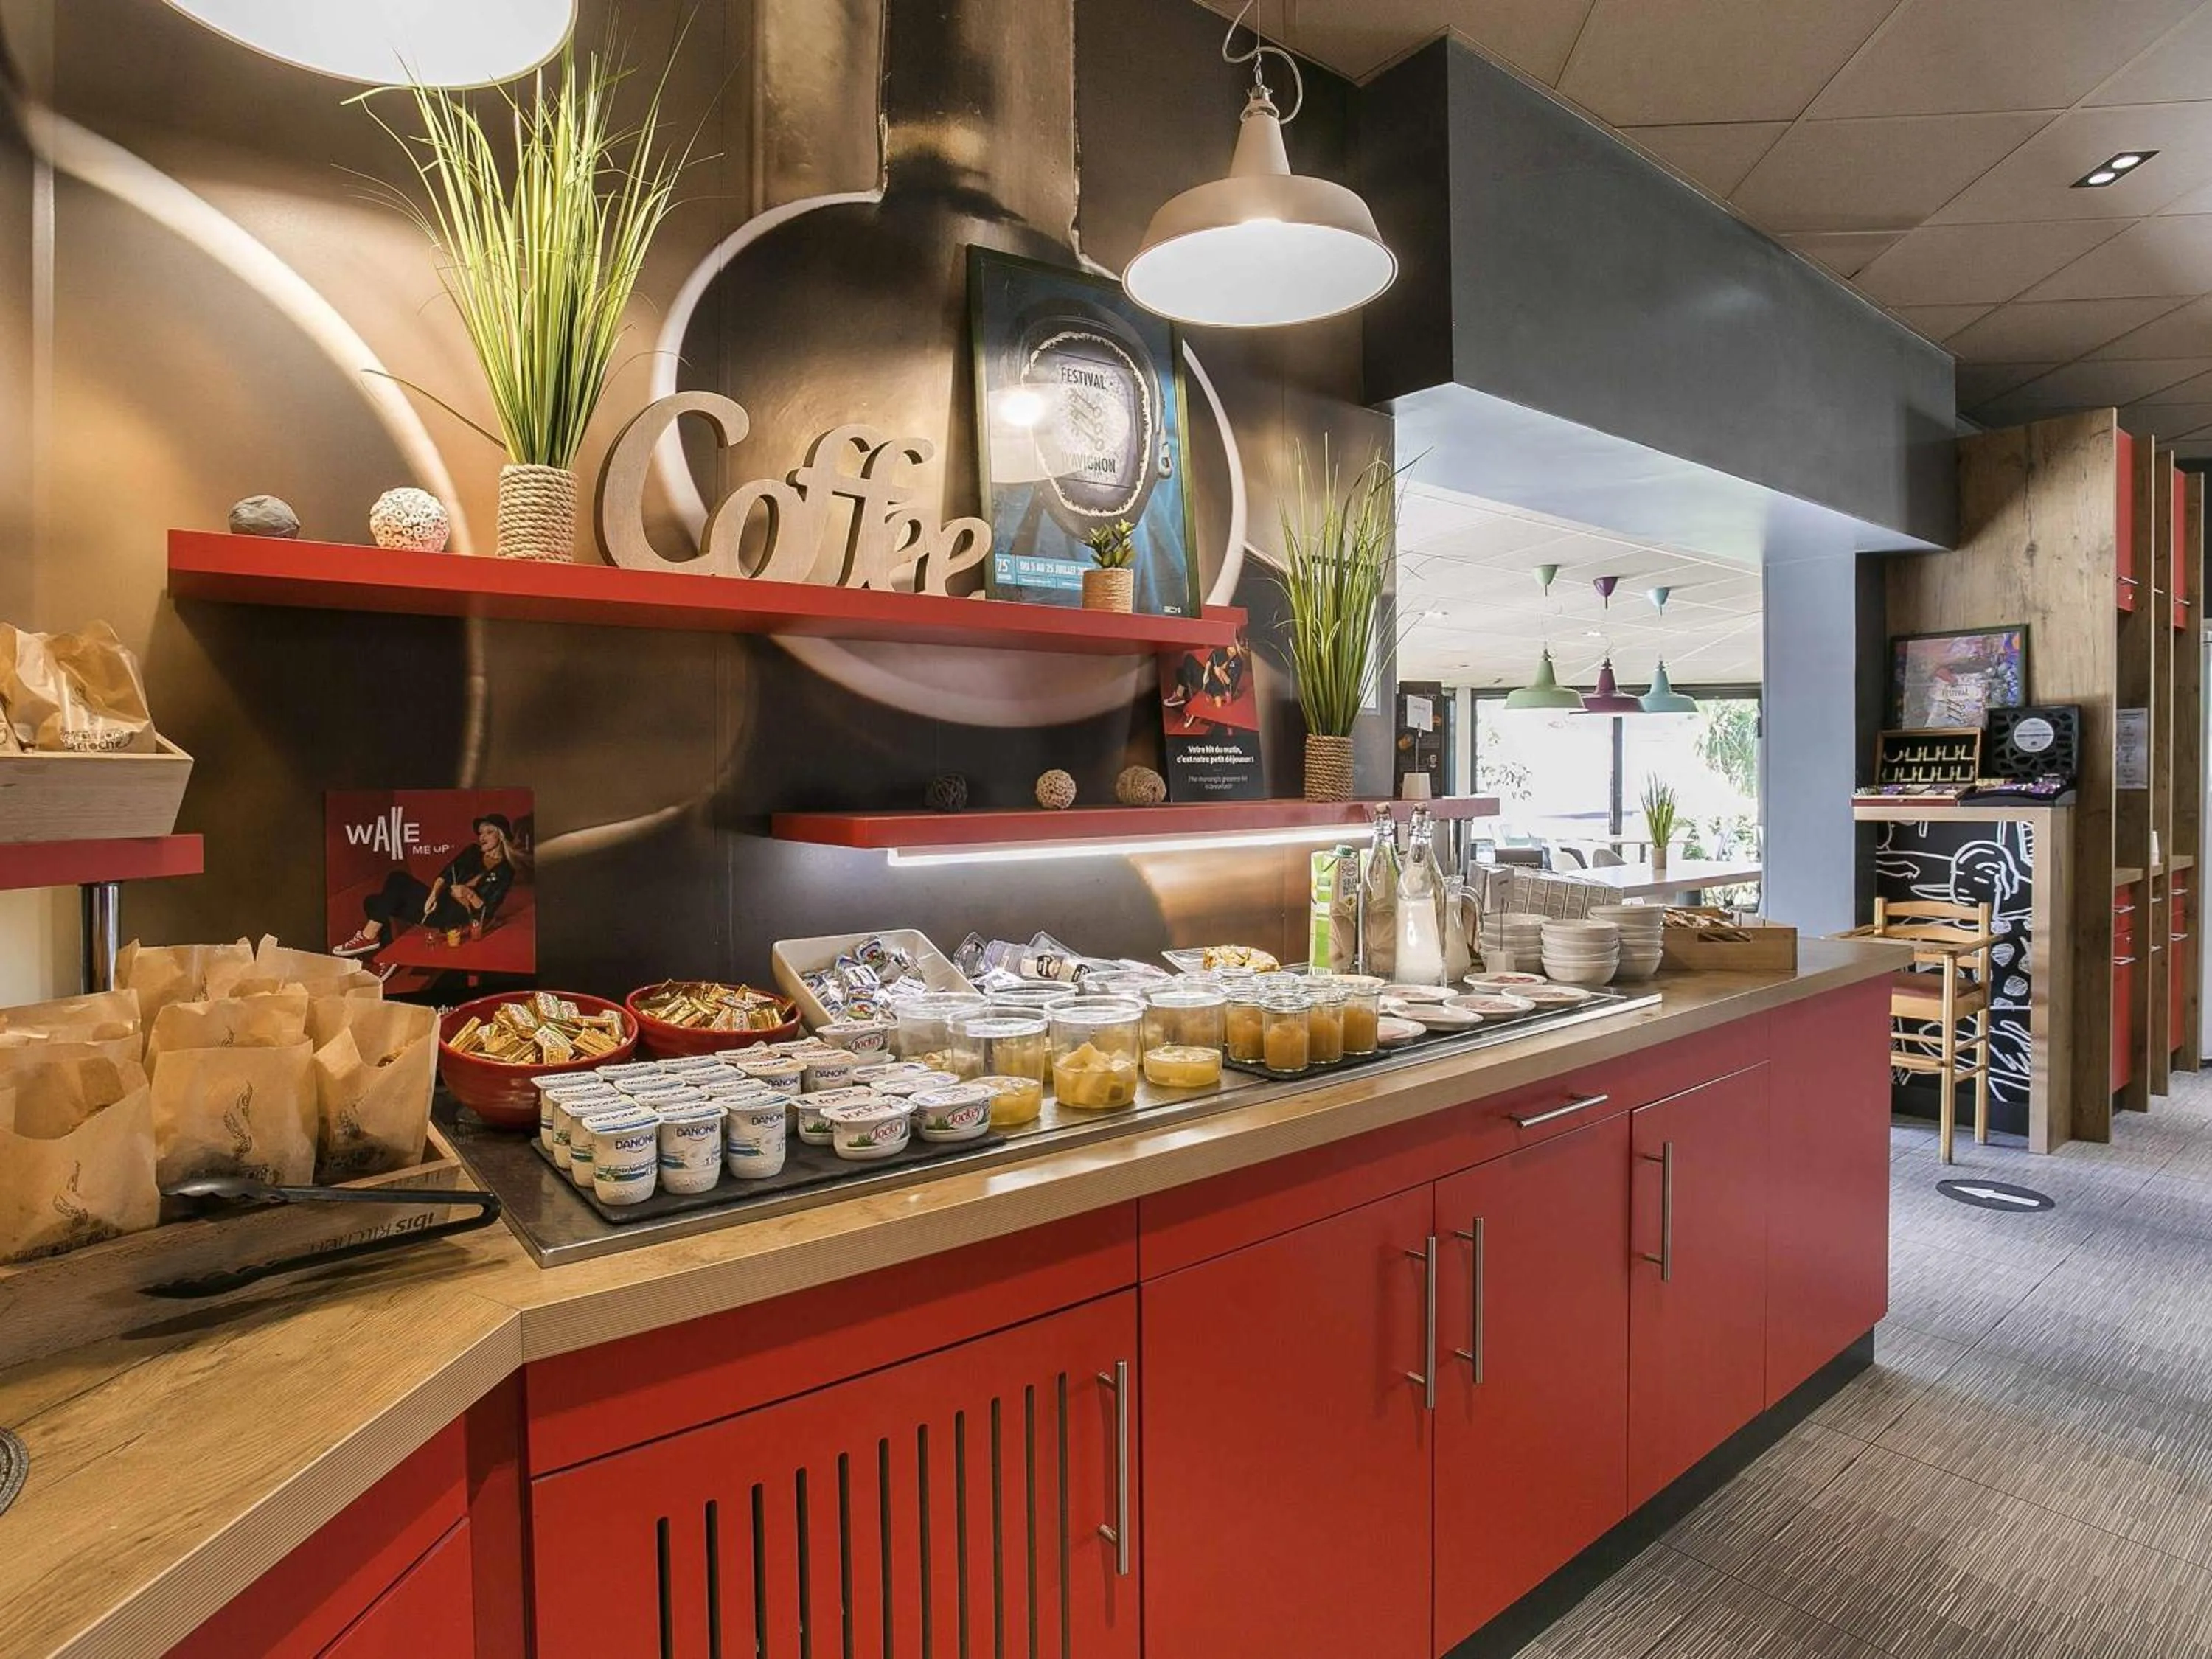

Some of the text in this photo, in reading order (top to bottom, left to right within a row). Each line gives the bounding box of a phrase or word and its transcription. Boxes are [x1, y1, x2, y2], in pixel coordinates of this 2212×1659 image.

[1060, 367, 1107, 389] FESTIVAL
[593, 391, 992, 601] Coffee
[1188, 745, 1205, 754] Votre
[1206, 745, 1214, 754] hit
[1214, 745, 1222, 754] du
[1176, 755, 1192, 763] c'est
[1210, 755, 1225, 765] petit
[345, 807, 420, 860] WAKE
[412, 844, 450, 855] ME UP
[676, 1123, 717, 1138] DANONE
[395, 1211, 435, 1234] ibis
